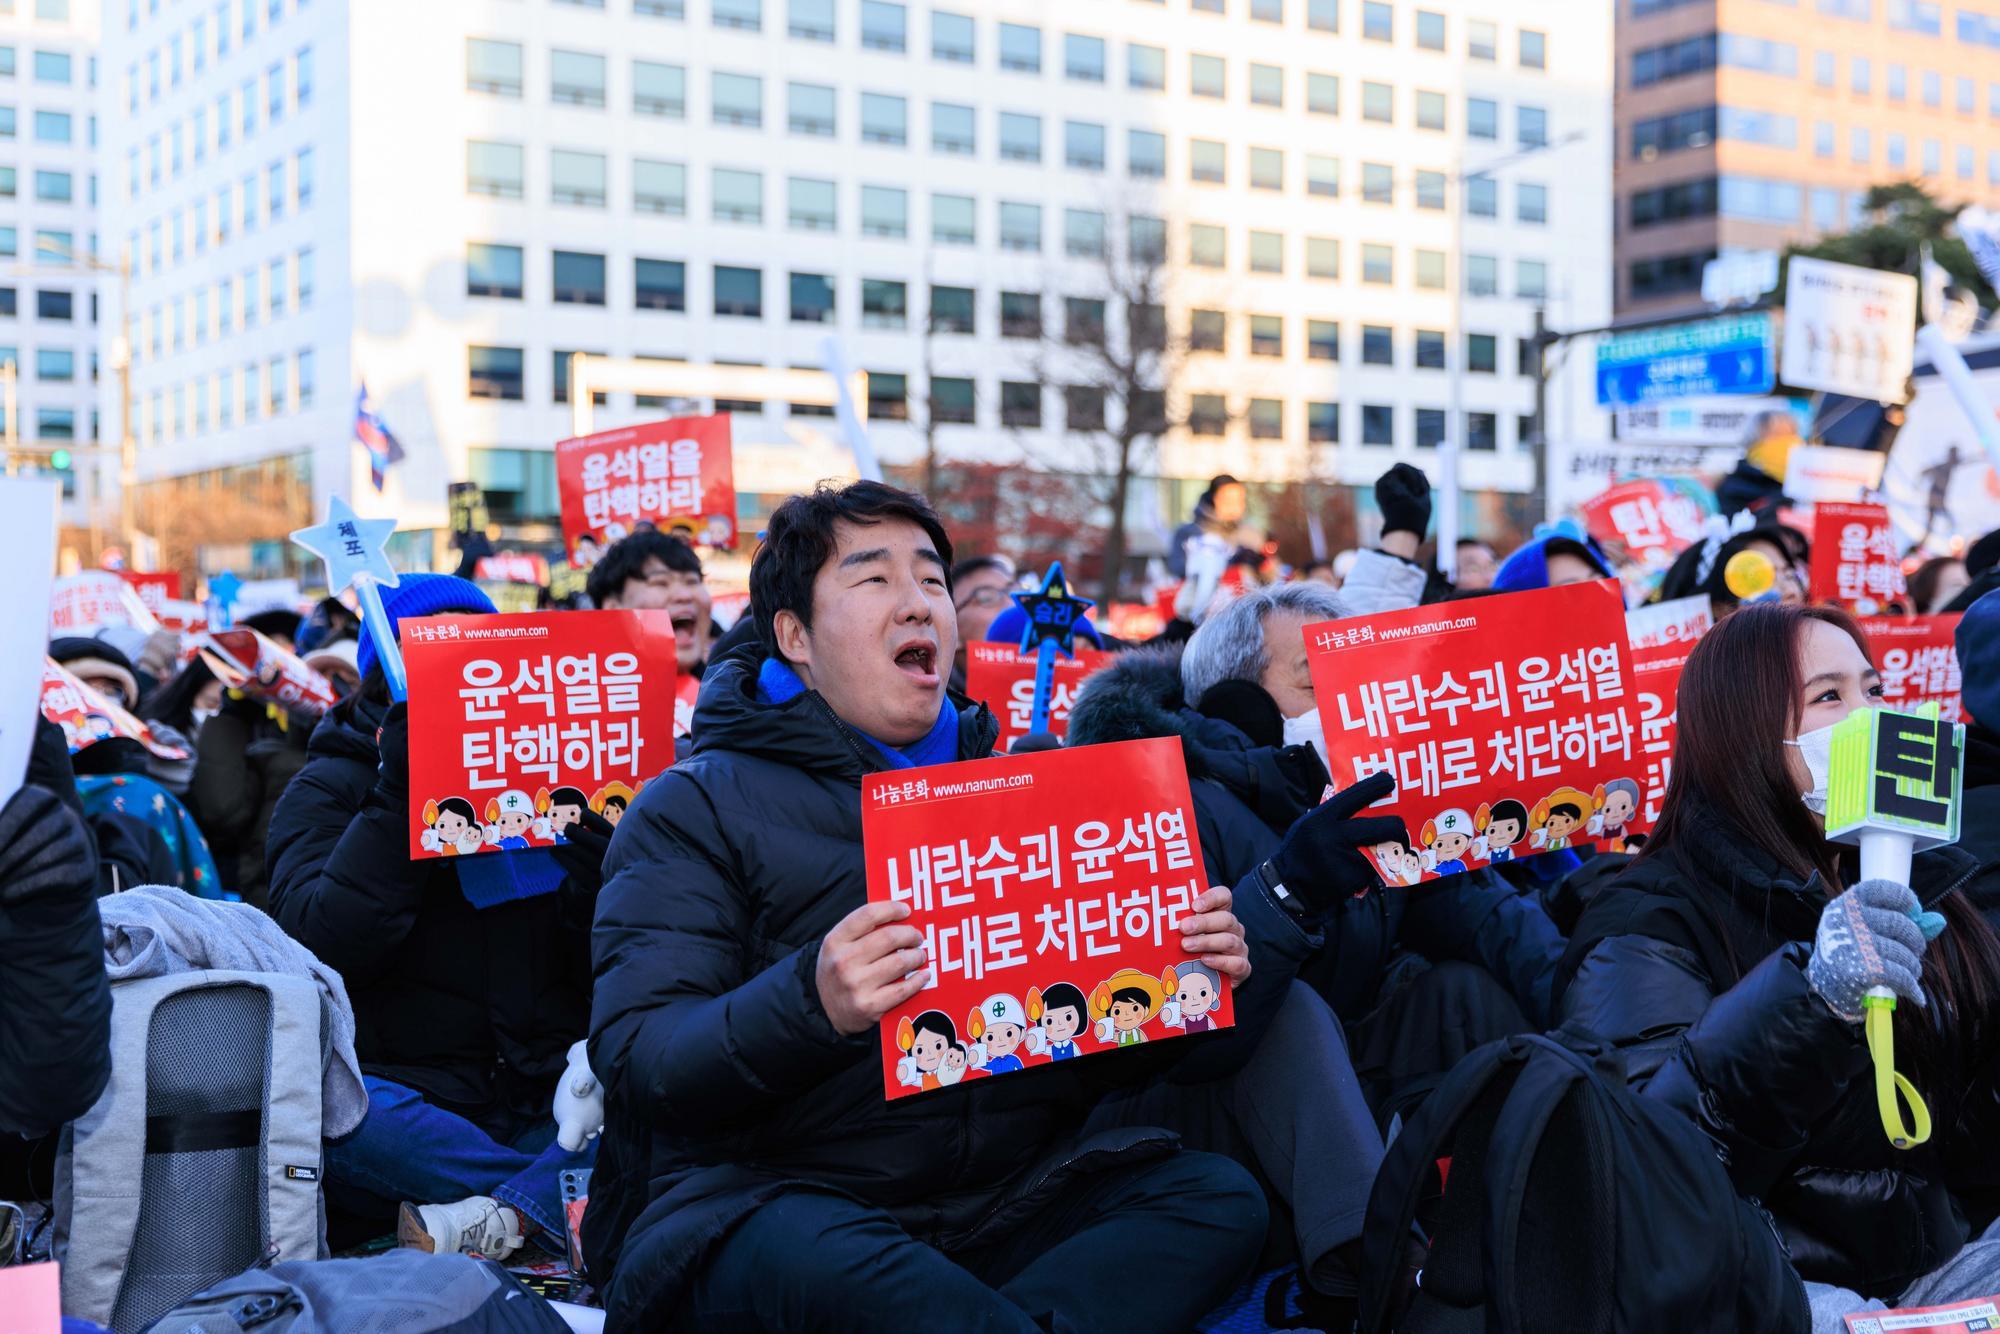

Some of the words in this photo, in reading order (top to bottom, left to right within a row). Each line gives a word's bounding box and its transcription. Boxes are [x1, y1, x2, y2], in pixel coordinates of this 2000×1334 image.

[581, 439, 703, 492] 윤석열을
[583, 476, 705, 529] 탄핵하라
[337, 521, 365, 556] 체포
[1838, 523, 1895, 561] 윤석
[410, 624, 461, 641] 나눔문화
[464, 624, 549, 640] www.nanum.com
[1034, 602, 1073, 625] 승리
[1315, 624, 1376, 651] 나눔문화
[1379, 614, 1478, 642] www.nanum.com
[458, 652, 643, 722] 윤석열을
[1336, 661, 1511, 739] 내란수괴
[1516, 643, 1625, 711] 윤석열
[462, 716, 644, 790] 탄핵하라
[1487, 707, 1635, 782] 처단하라
[1874, 711, 1959, 826] 탄
[872, 778, 931, 806] 나눔문화
[933, 772, 1034, 799] www.nanum.com
[886, 825, 1062, 912] 내란수괴
[1070, 807, 1195, 884] 윤석열
